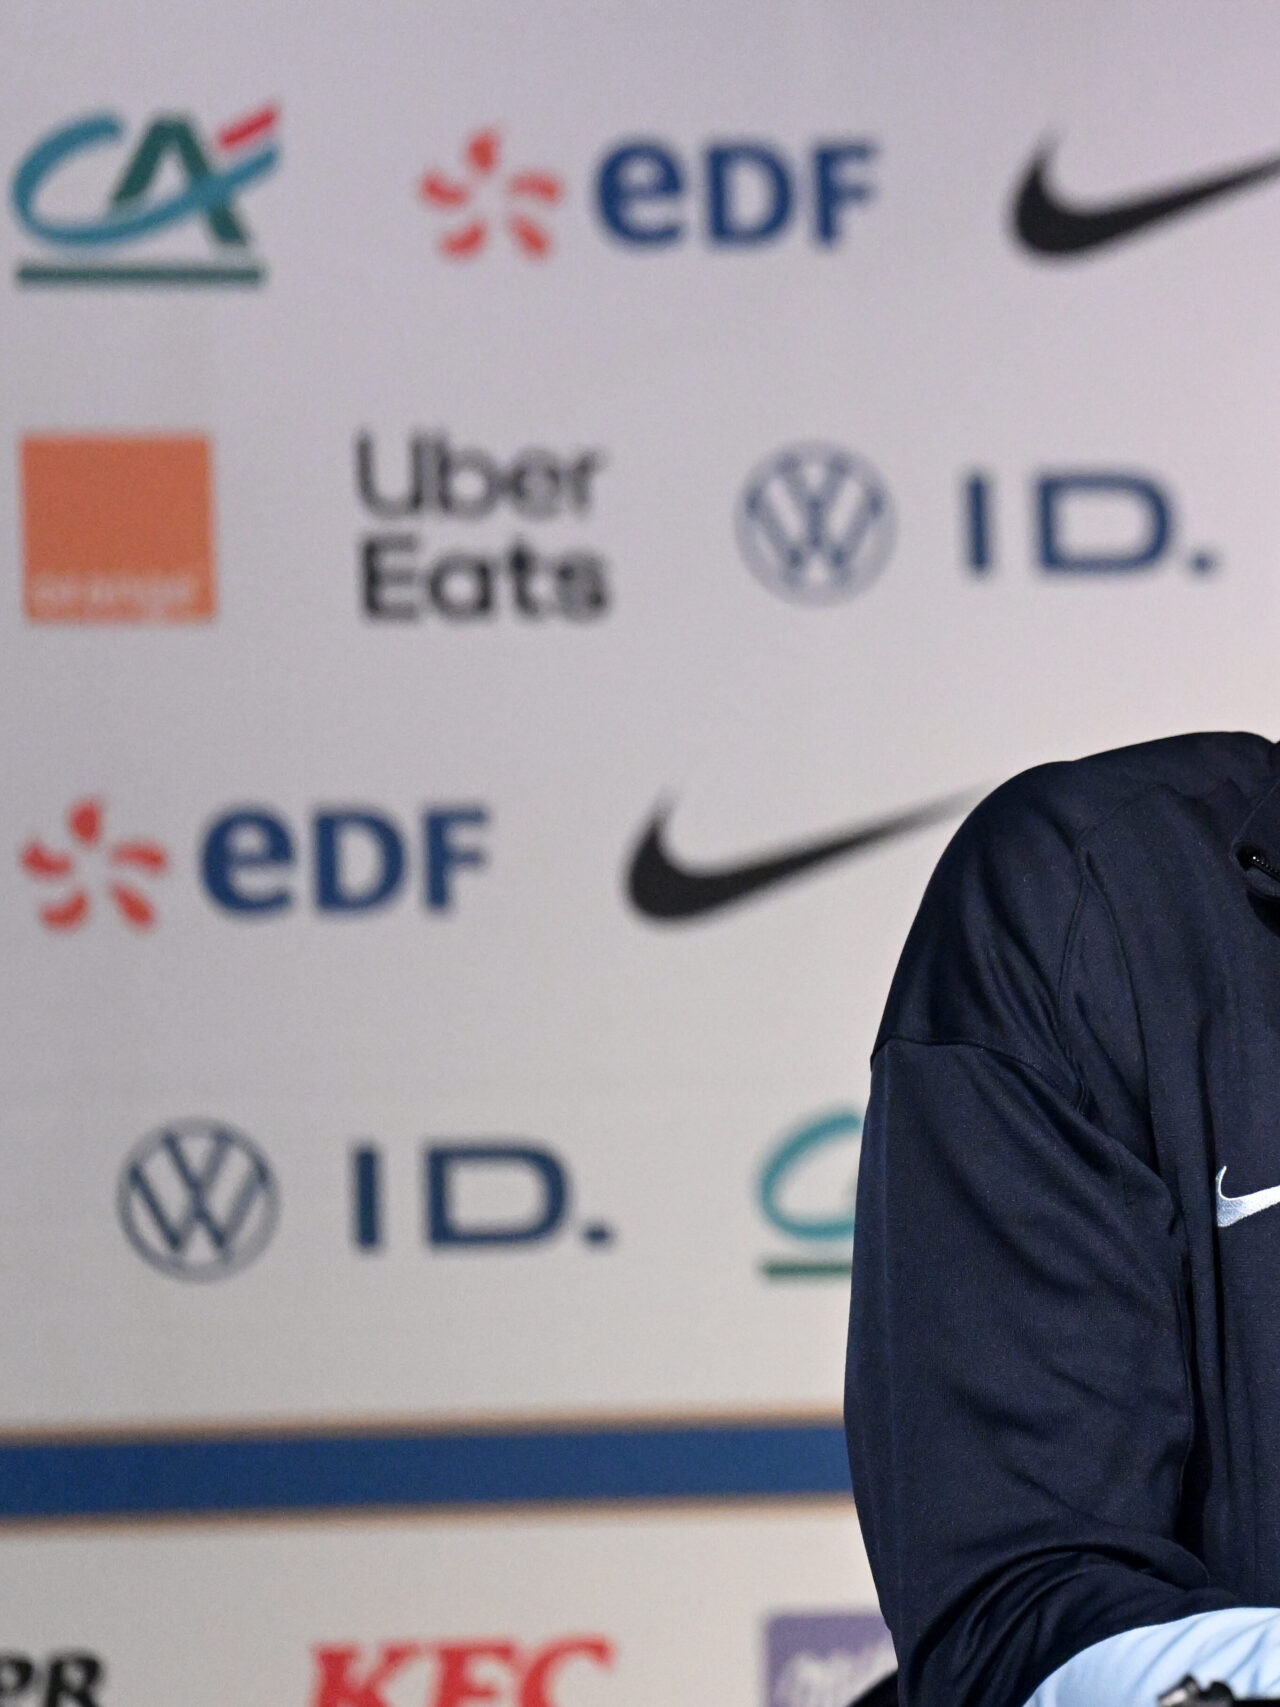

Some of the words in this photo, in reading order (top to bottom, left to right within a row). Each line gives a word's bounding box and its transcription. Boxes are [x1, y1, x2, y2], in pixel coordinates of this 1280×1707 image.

[353, 430, 602, 521] Uber
[357, 531, 611, 624] Eats
[309, 1636, 613, 1707] KFC
